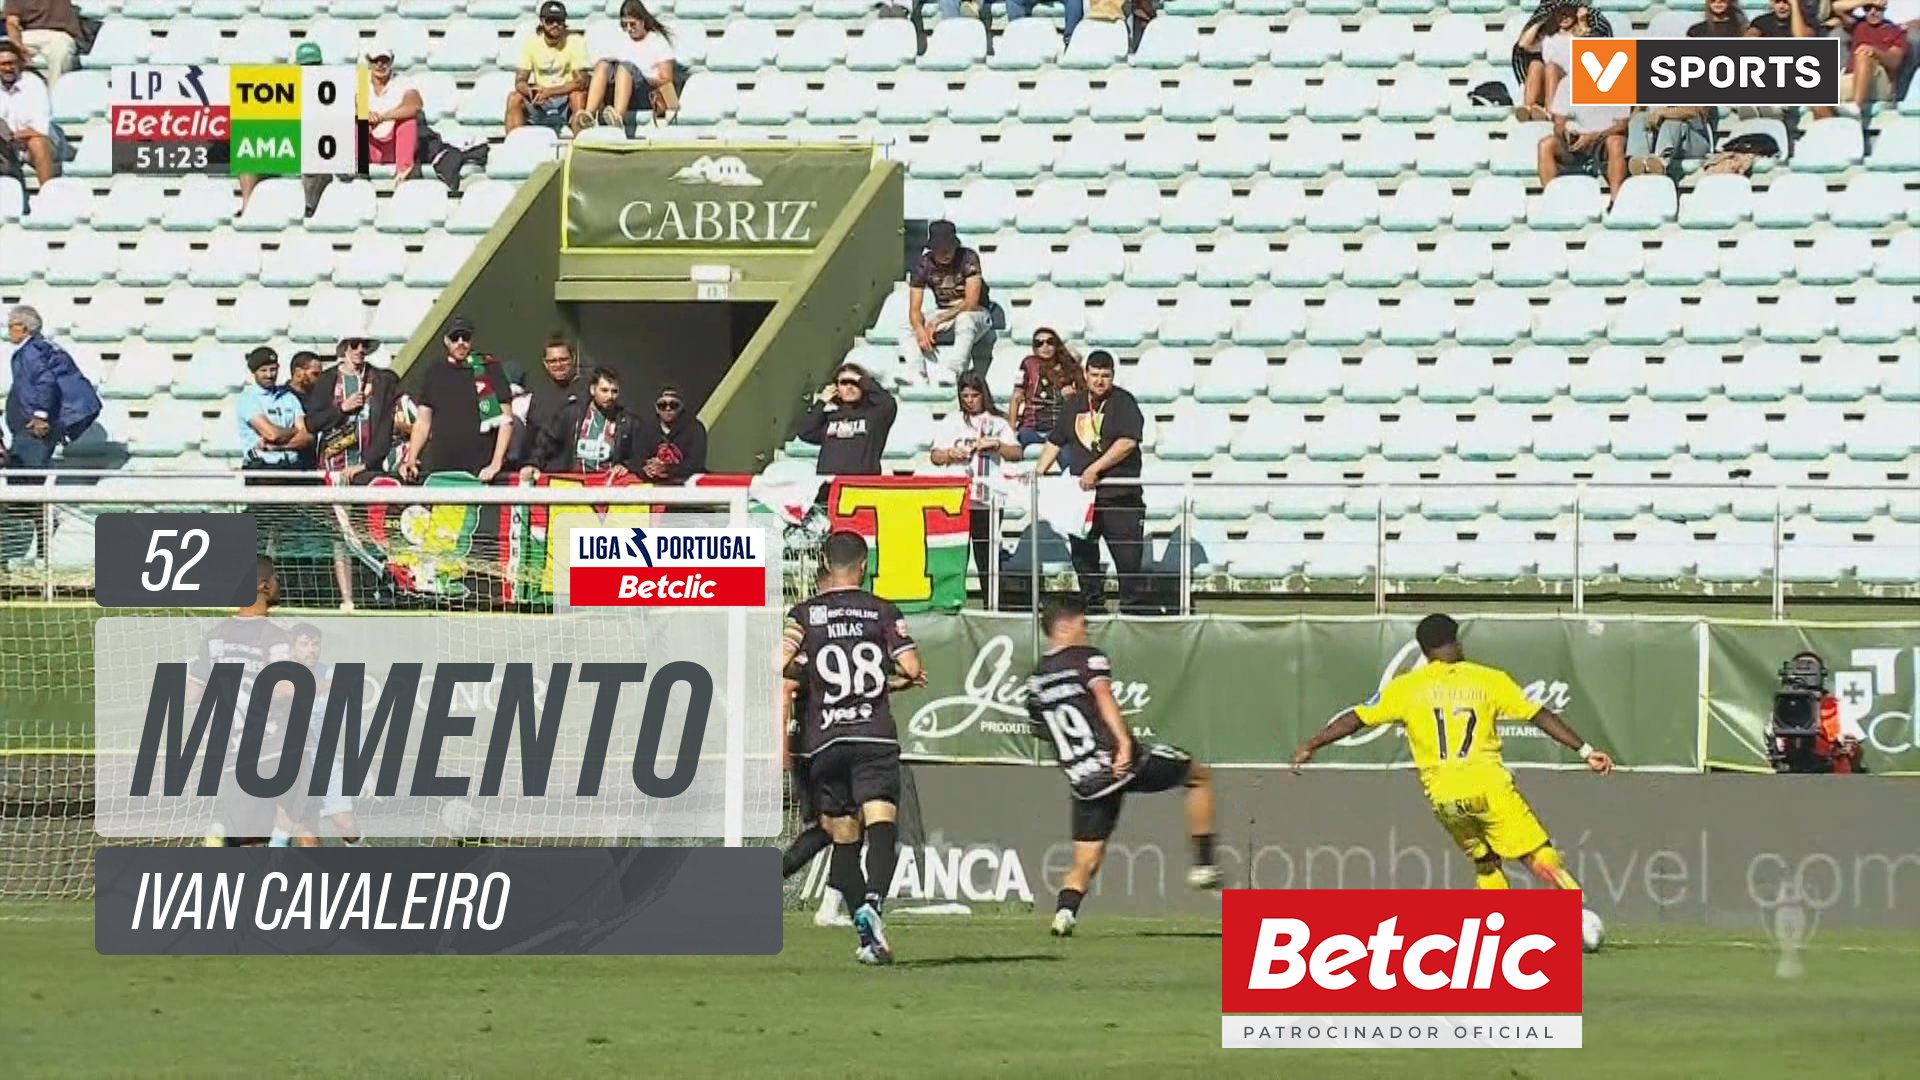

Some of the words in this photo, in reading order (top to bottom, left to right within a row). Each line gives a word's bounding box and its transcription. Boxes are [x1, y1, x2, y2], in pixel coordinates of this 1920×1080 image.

[618, 200, 812, 242] CABRIZ
[827, 623, 864, 638] KIKAS
[816, 642, 885, 704] 98
[1042, 703, 1096, 762] 19
[1433, 707, 1478, 760] 17
